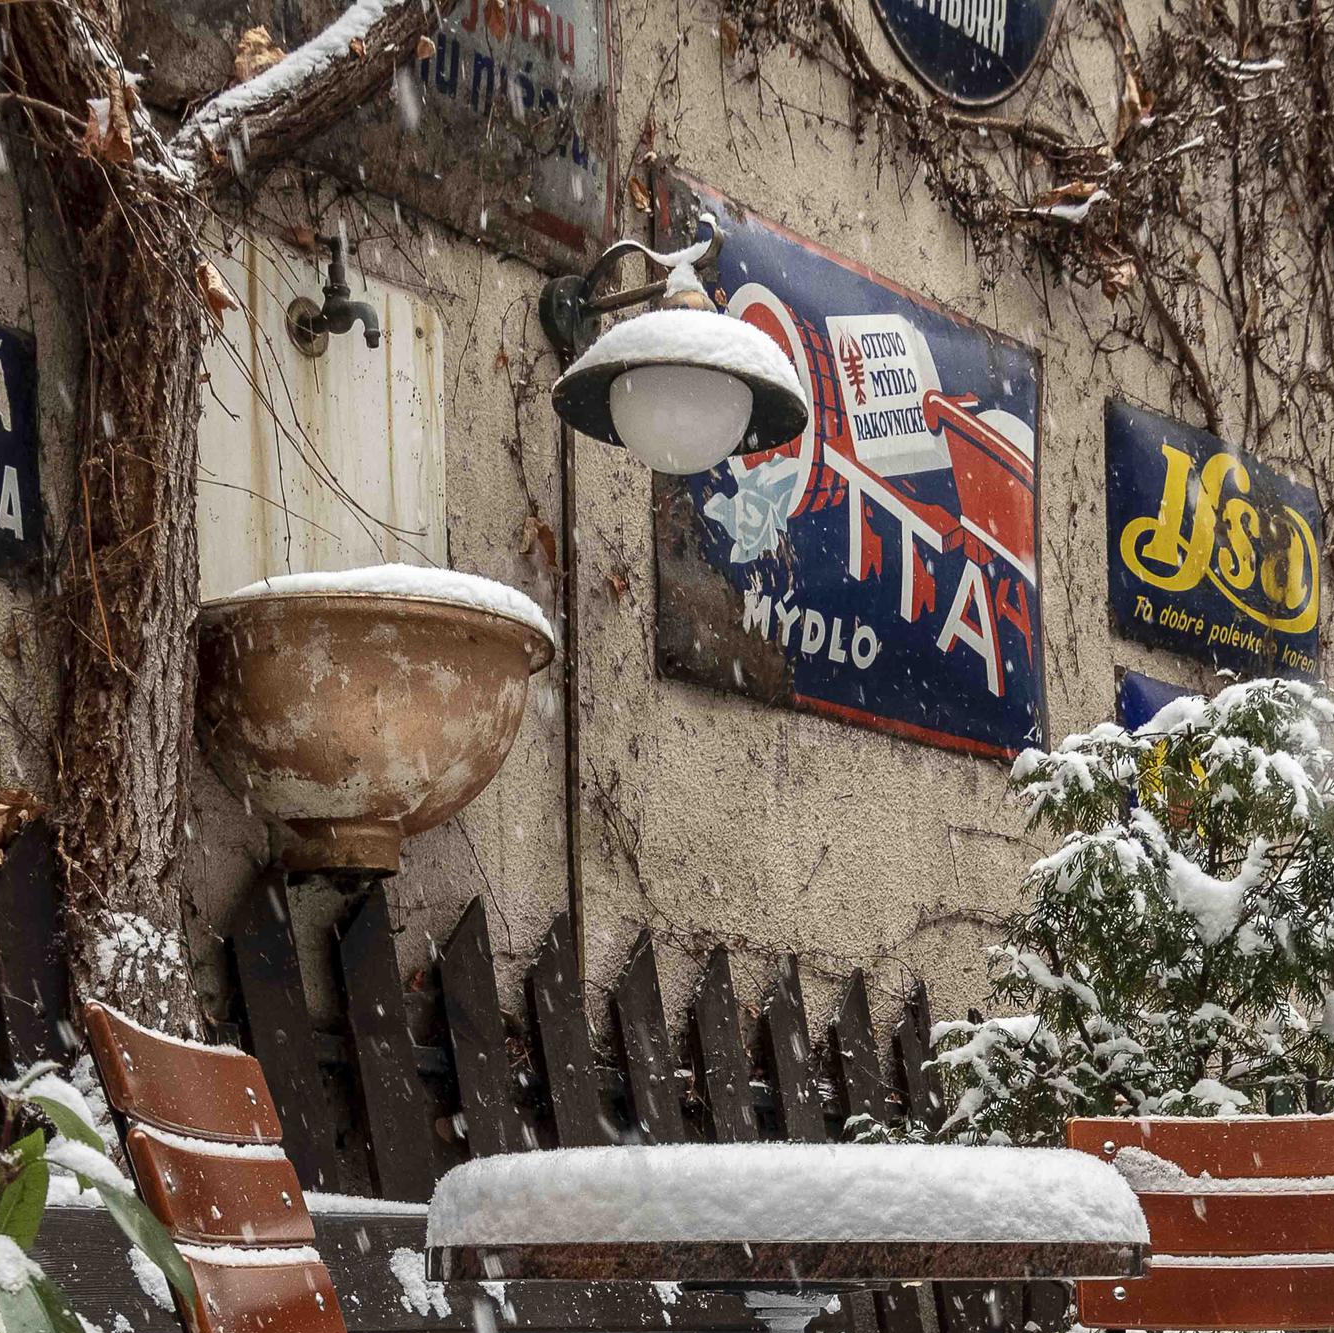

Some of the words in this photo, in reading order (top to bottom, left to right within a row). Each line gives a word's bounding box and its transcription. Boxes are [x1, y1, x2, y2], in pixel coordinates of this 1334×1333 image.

[860, 331, 906, 359] OTTOVO
[870, 363, 917, 397] MÝDLO
[853, 401, 926, 440] RAKOVNICKÉ
[742, 589, 877, 670] MÝDLO
[1159, 604, 1204, 636] dobré
